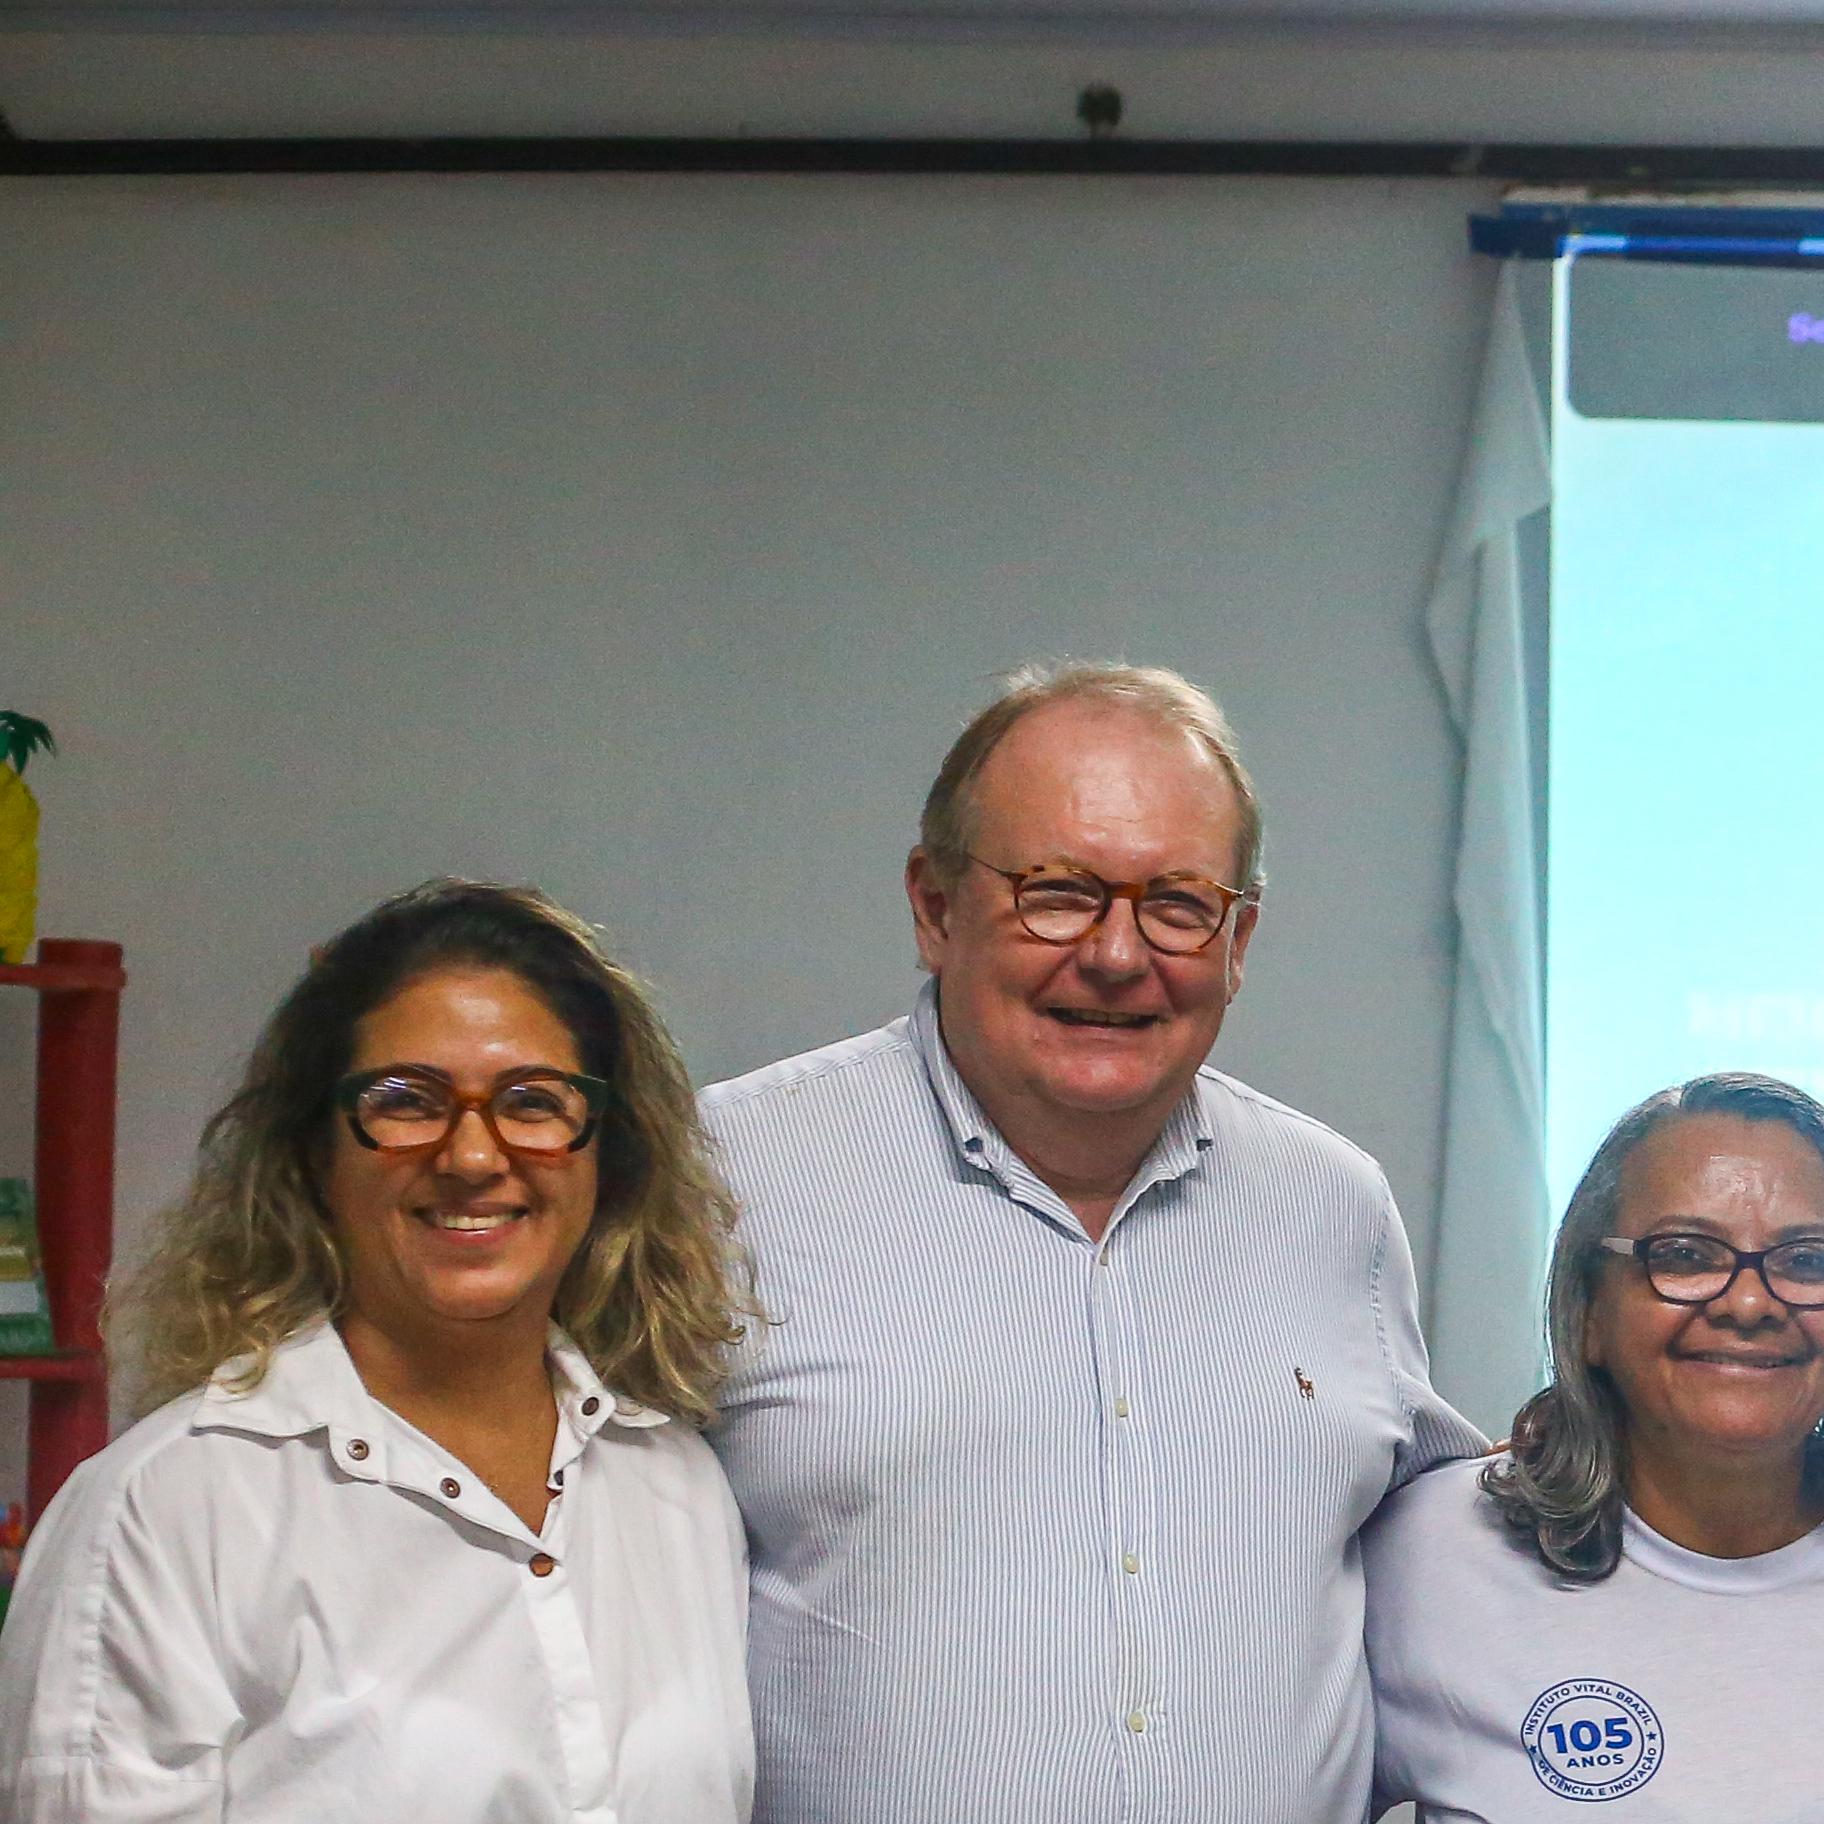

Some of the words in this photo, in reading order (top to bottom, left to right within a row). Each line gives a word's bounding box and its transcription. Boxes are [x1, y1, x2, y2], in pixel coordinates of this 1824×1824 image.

[1524, 1687, 1571, 1735] INSTITUTO
[1573, 1683, 1613, 1697] VITAL
[1615, 1690, 1654, 1726] BRAZIL
[1546, 1716, 1633, 1754] 105
[1538, 1759, 1551, 1777] DE
[1549, 1774, 1595, 1797] CIÊNCIA
[1598, 1787, 1607, 1797] E
[1609, 1747, 1657, 1795] INOVAÇÃO
[1566, 1753, 1625, 1769] ANOS
